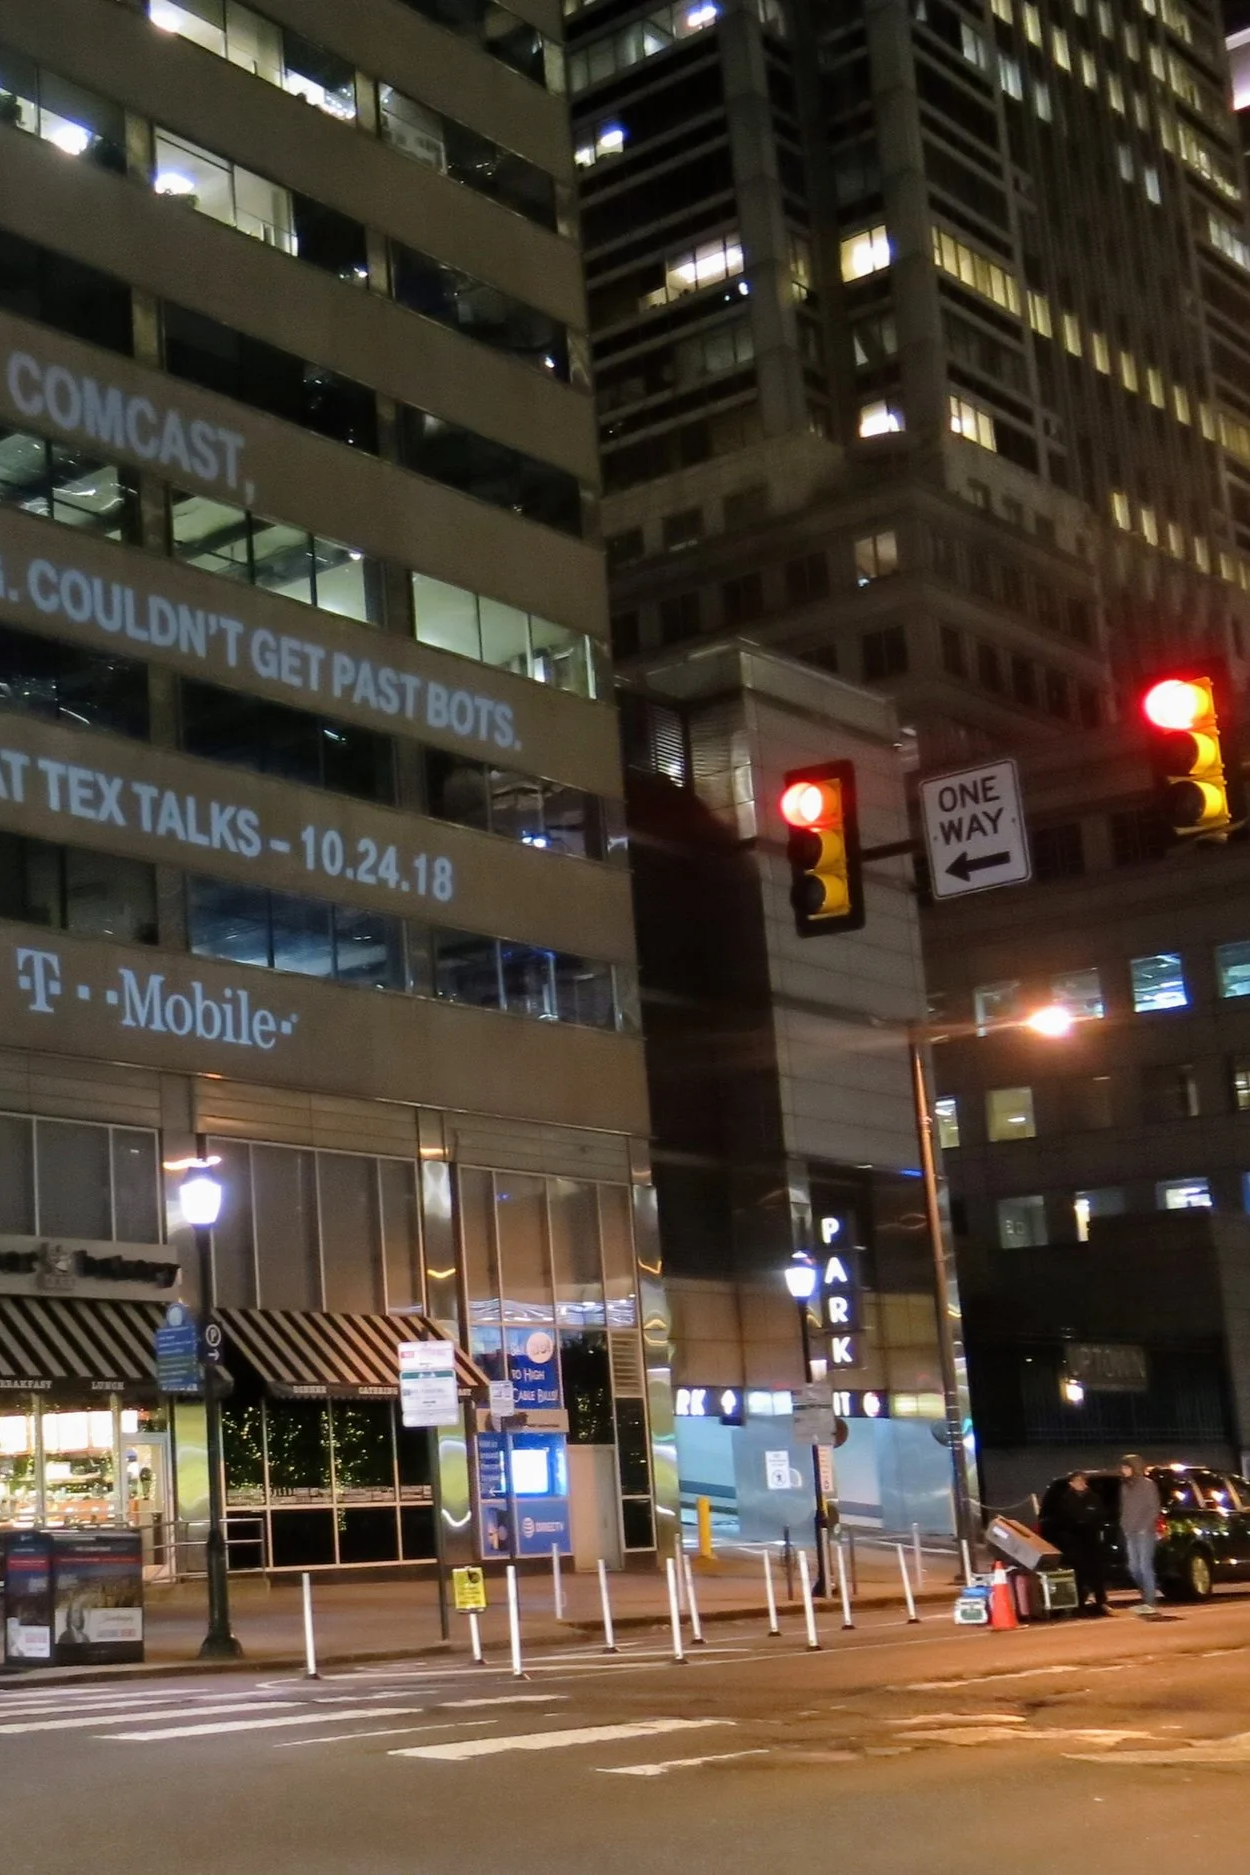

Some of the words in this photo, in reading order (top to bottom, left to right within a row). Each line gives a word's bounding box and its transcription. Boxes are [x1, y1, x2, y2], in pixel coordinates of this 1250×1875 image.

[7, 351, 255, 505] COMCAST,
[26, 559, 244, 668] COULDN'T
[251, 629, 326, 688] GET
[332, 652, 421, 715] PAST
[426, 681, 523, 752] BOTS.
[38, 759, 127, 826] TEX
[131, 782, 262, 858] TALKS
[301, 825, 455, 902] 10.24.18
[937, 775, 1001, 814] ONE
[938, 807, 1005, 846] WAY
[821, 1217, 853, 1364] PARK
[91, 1380, 125, 1391] LUNCH
